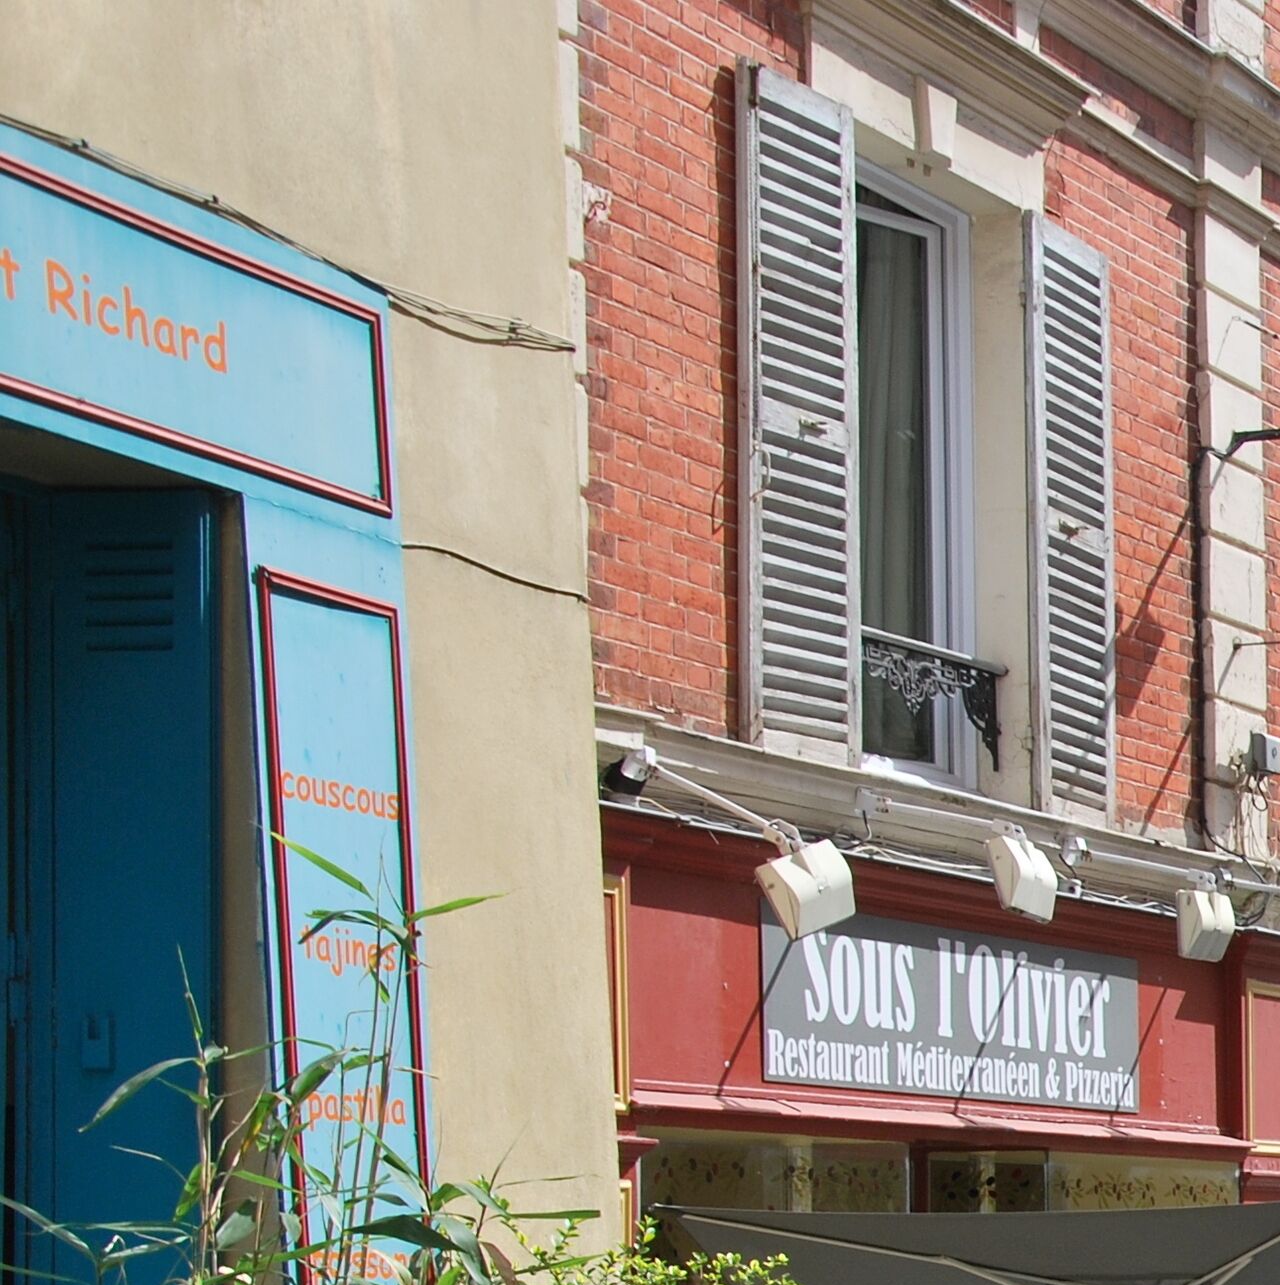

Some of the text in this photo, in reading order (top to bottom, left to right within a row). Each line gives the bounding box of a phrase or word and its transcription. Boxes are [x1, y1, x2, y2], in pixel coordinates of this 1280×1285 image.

[45, 258, 229, 375] Richard
[281, 771, 400, 821] couscous
[802, 931, 1110, 1059] Sous l'Olivier
[767, 1028, 1135, 1108] Restaurant Méditerranéen & Pizzeria
